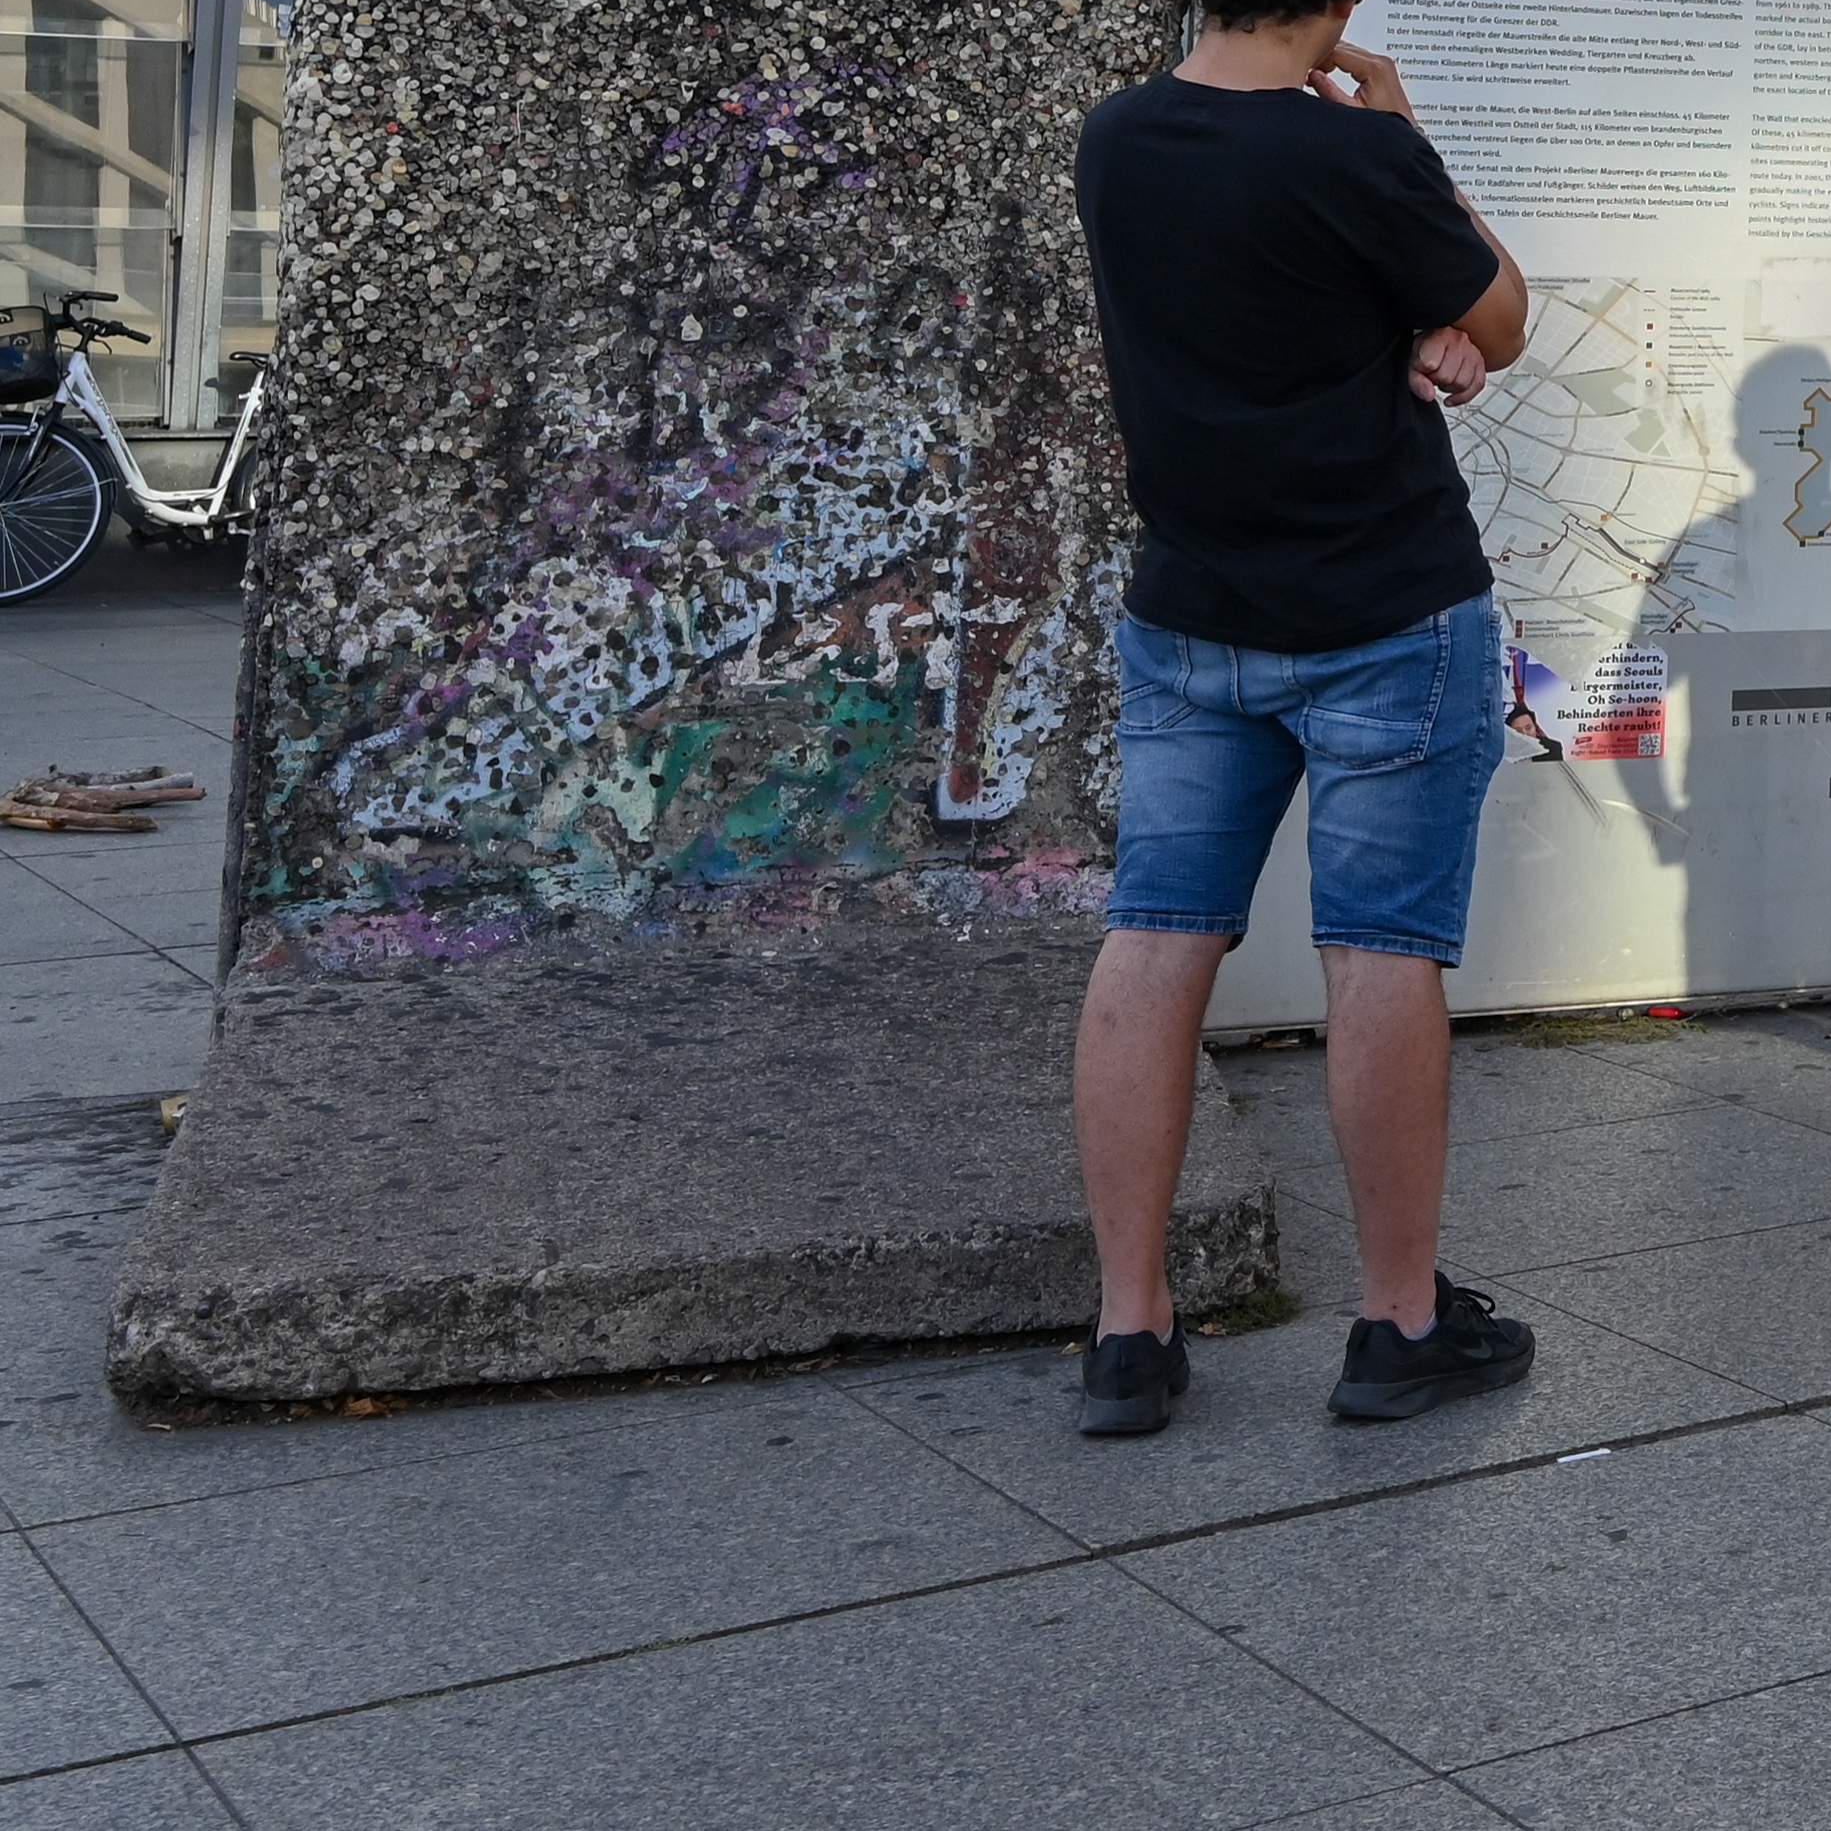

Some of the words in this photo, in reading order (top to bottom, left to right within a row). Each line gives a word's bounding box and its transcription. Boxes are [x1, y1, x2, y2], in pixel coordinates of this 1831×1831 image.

[1598, 653, 1663, 666] erhindern,
[1594, 667, 1621, 677] dass
[1623, 666, 1662, 676] Seouls
[1587, 694, 1605, 705] Oh
[1608, 694, 1661, 708] Se-hoon,
[1557, 709, 1633, 719] Behinderten
[1636, 707, 1660, 722] ihre
[1577, 722, 1620, 732] Rechte
[1623, 720, 1660, 730] raubt!
